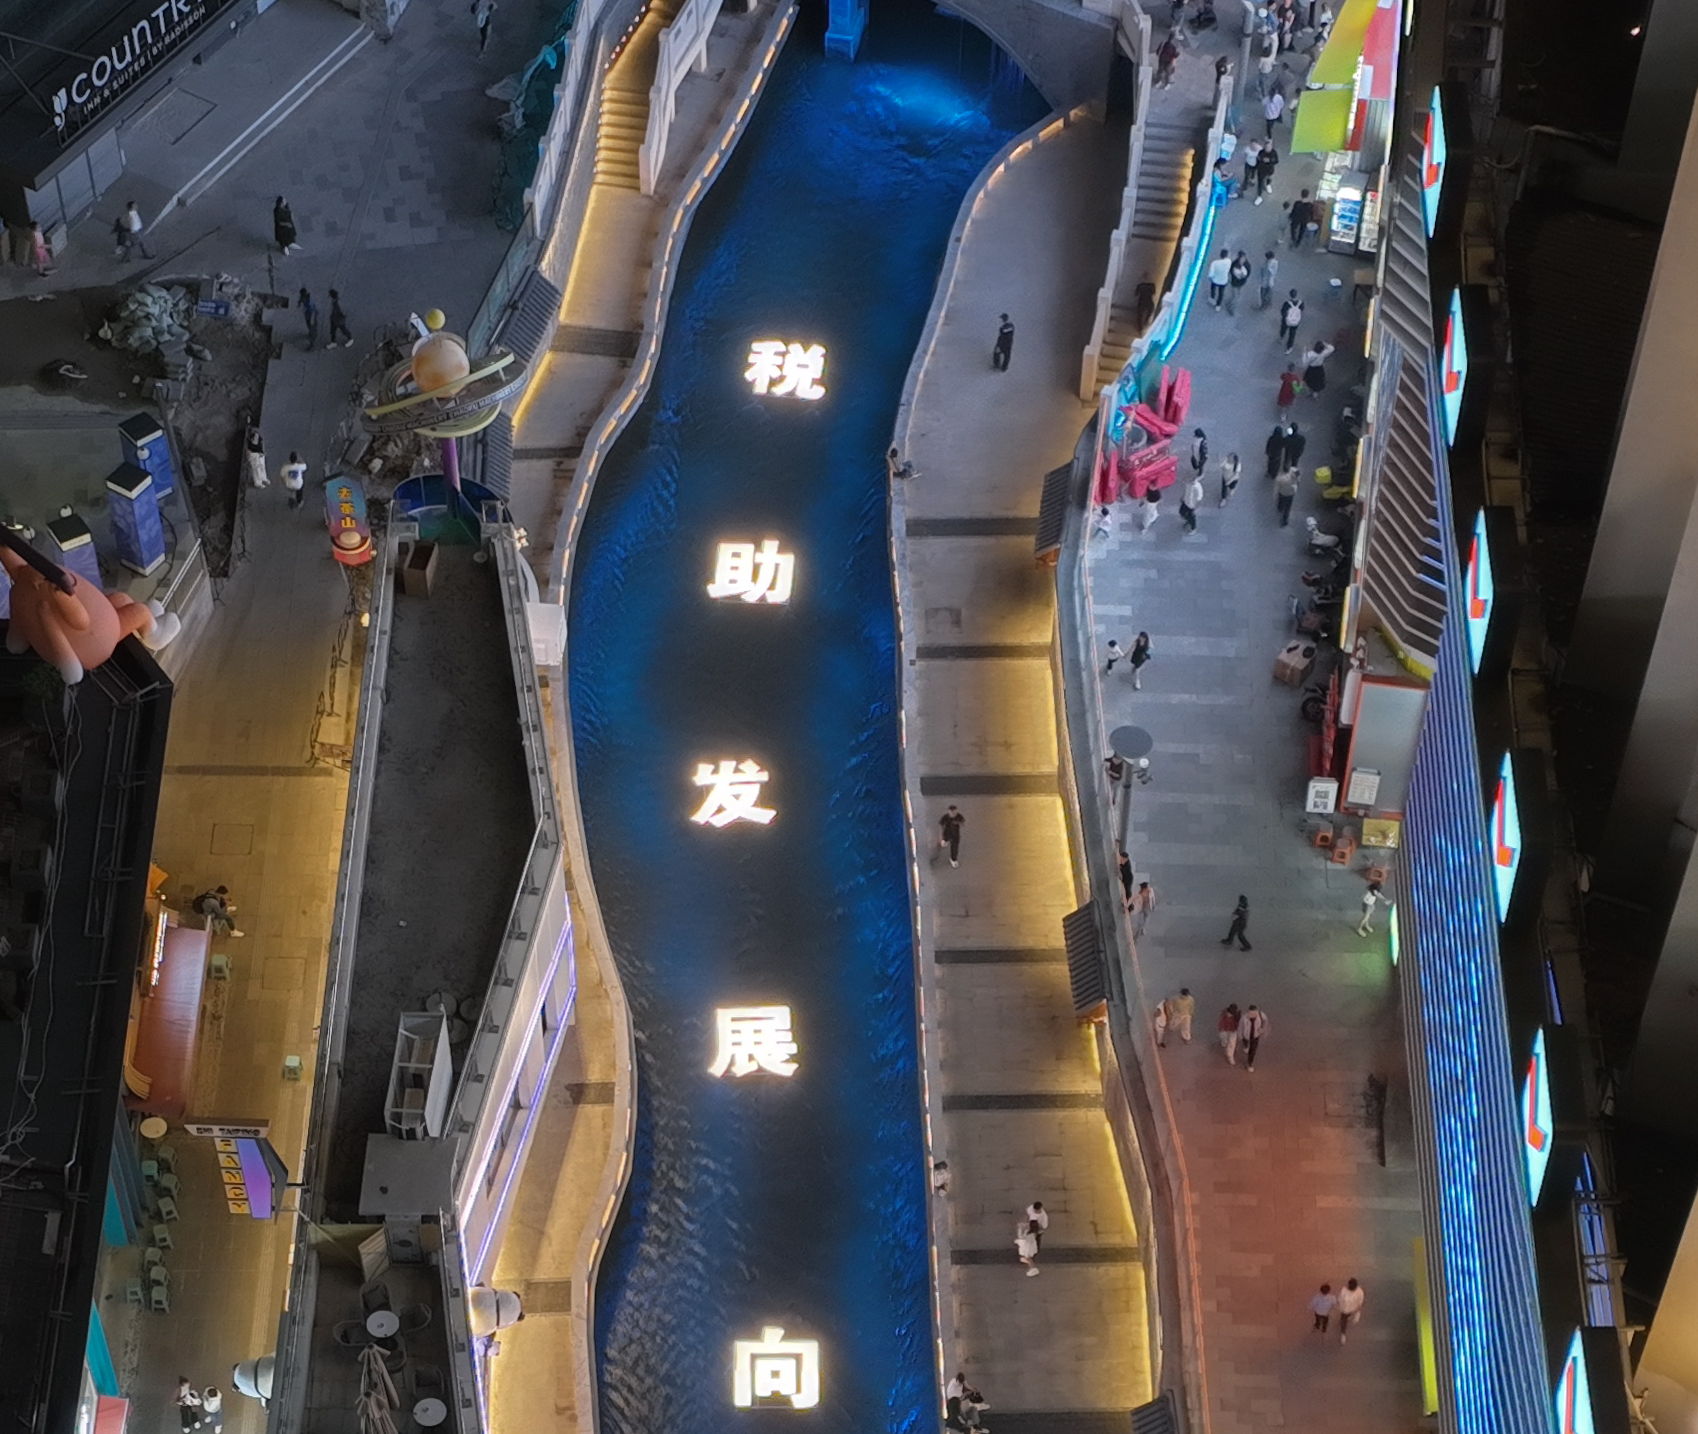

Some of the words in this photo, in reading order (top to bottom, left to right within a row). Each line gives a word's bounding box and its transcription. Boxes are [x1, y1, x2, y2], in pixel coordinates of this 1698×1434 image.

[70, 0, 204, 104] COUNTR
[83, 96, 102, 115] INN
[112, 57, 146, 91] SUITES
[152, 42, 164, 56] BY
[164, 5, 207, 46] RADISSON
